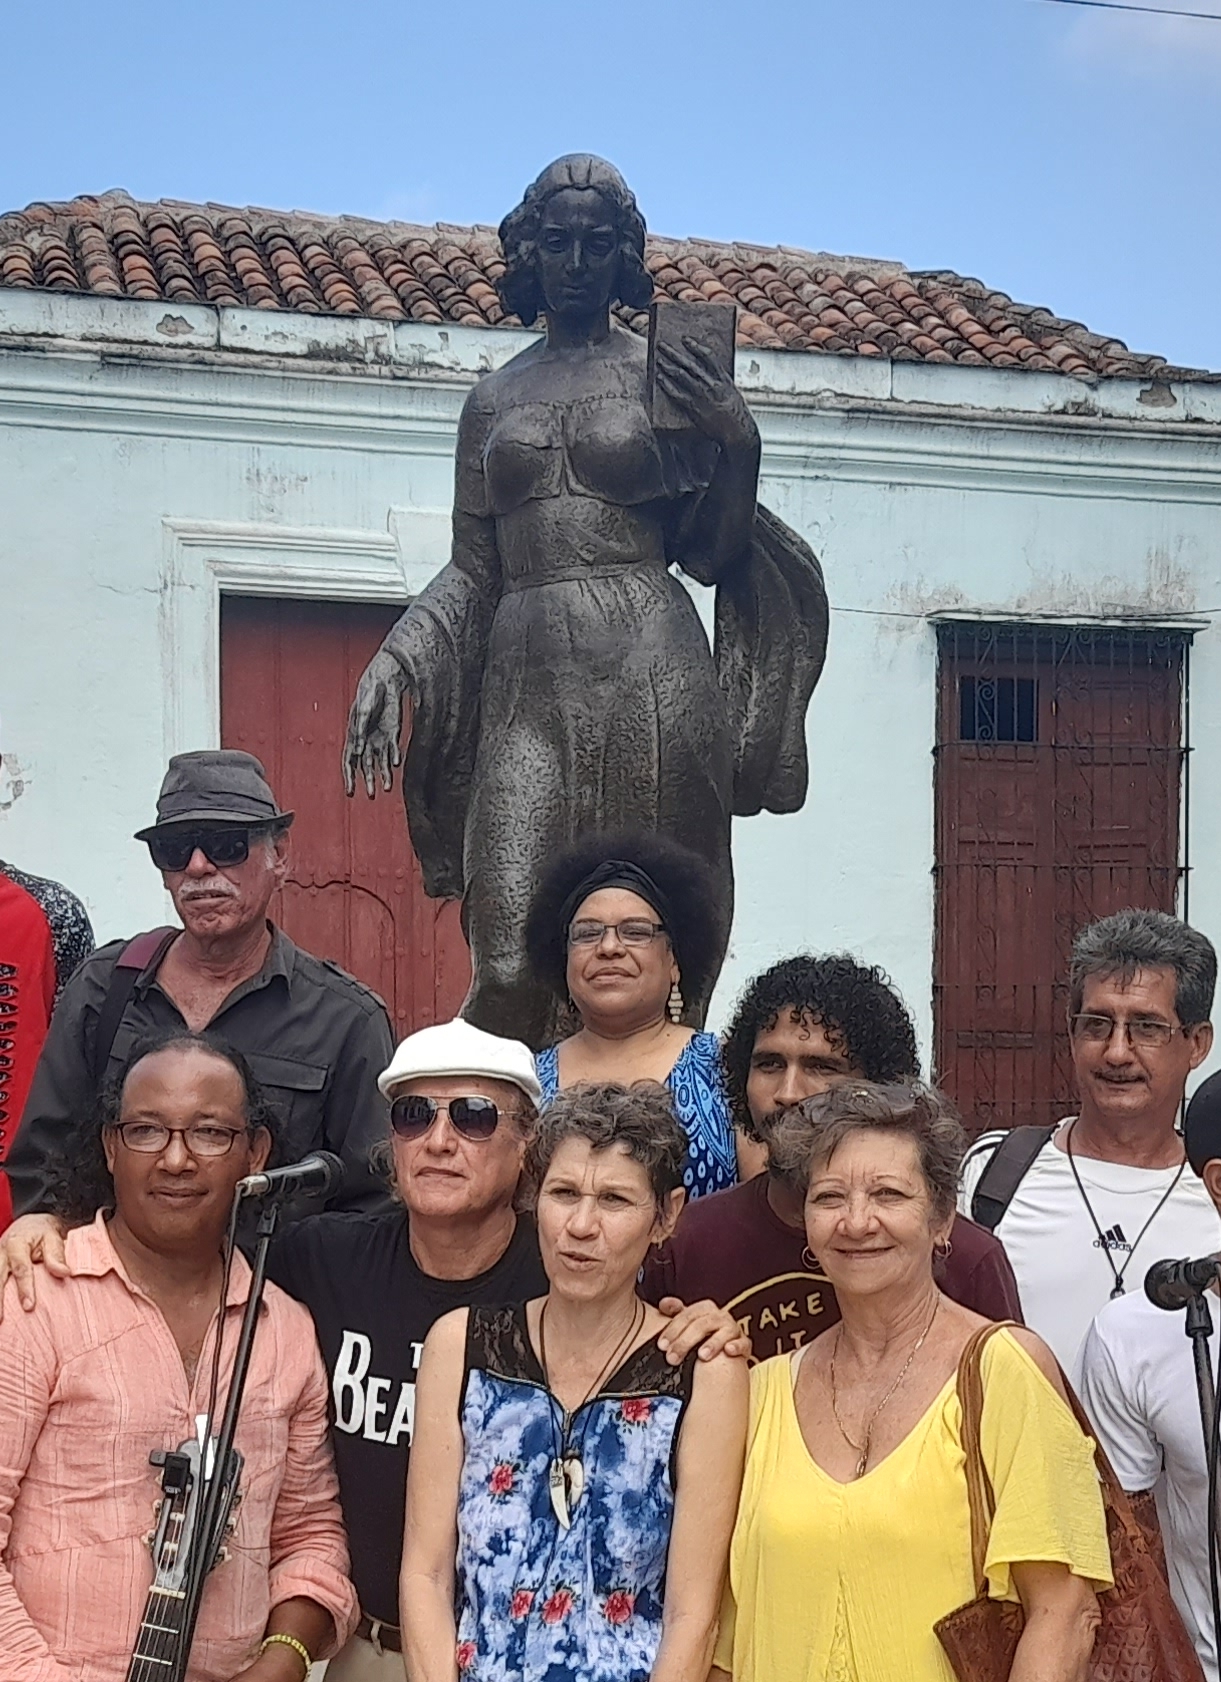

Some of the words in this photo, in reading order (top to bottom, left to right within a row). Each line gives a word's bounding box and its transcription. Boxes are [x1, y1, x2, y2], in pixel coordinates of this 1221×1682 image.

[1092, 1237, 1132, 1253] aidas
[737, 1292, 824, 1336] TAKE
[776, 1330, 807, 1355] IT
